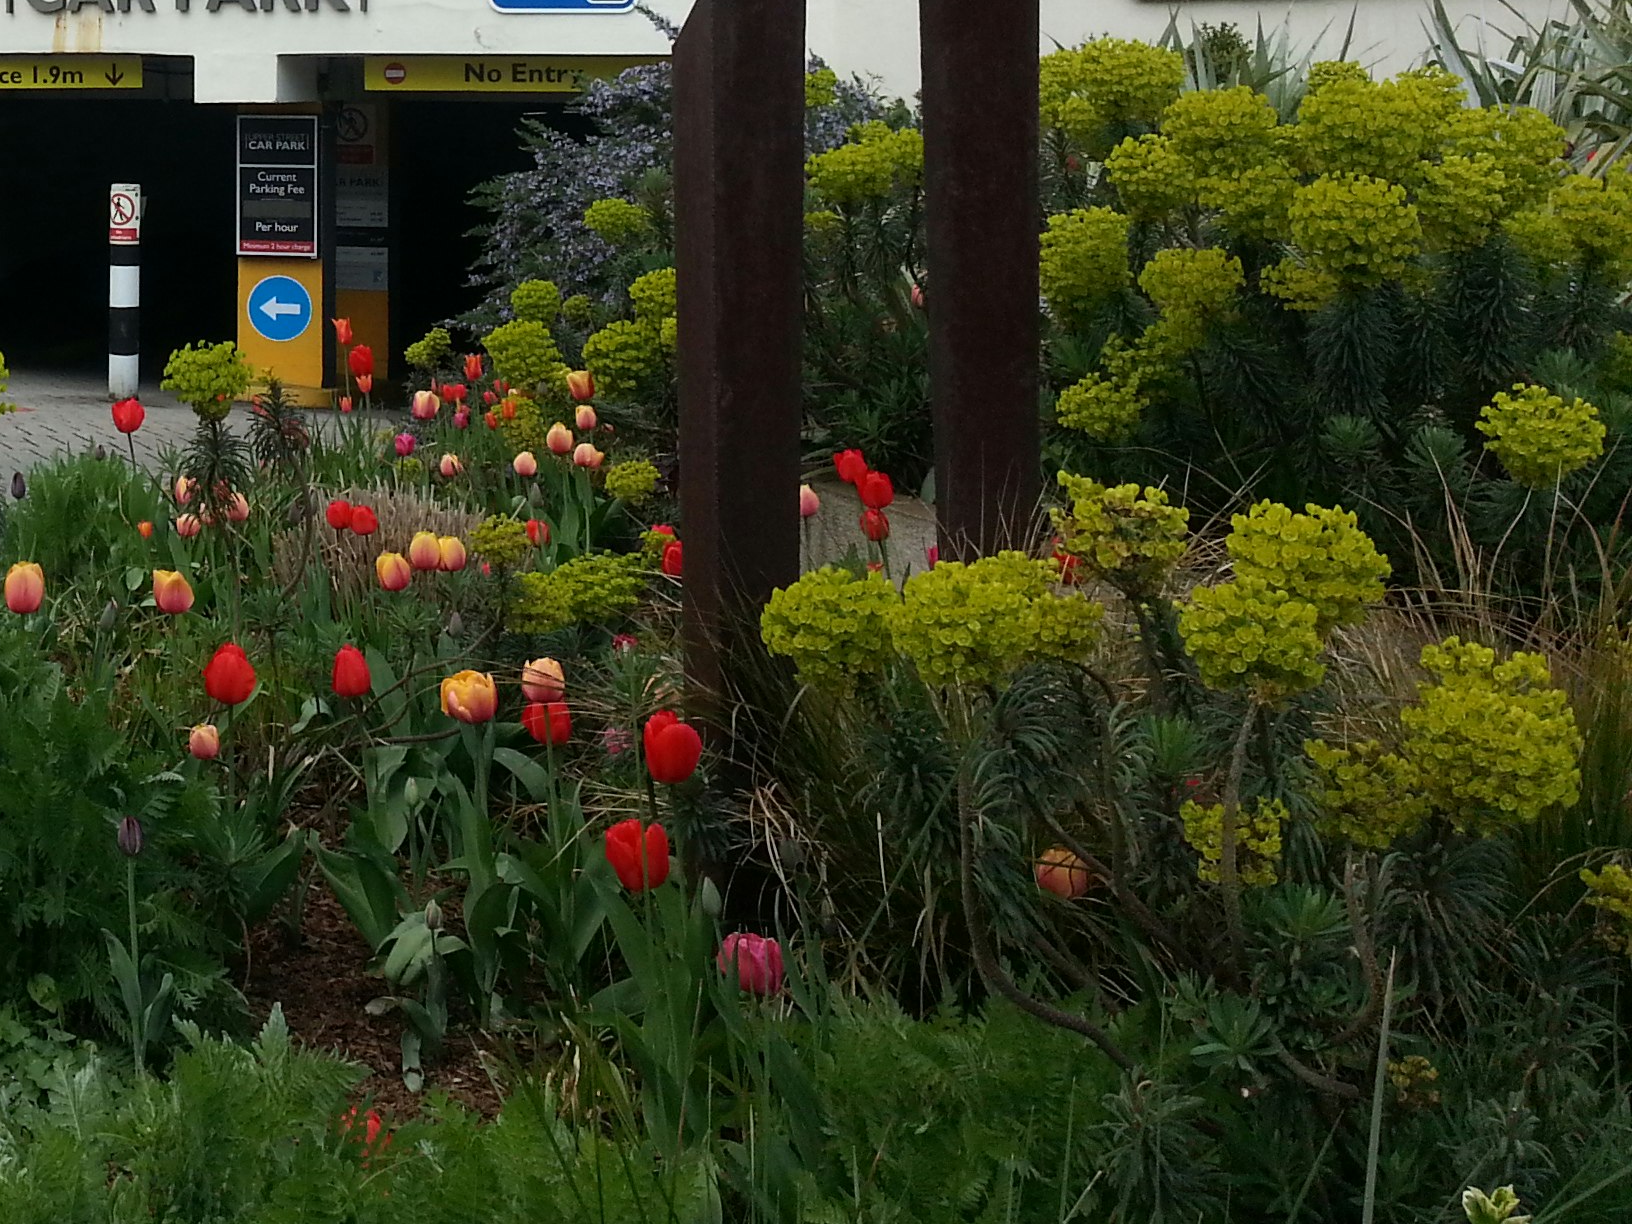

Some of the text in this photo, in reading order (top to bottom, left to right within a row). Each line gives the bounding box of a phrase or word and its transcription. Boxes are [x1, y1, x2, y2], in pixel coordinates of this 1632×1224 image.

[32, 65, 83, 84] 1.9m
[464, 63, 583, 89] No Entry
[248, 141, 305, 151] CAR PARK
[257, 171, 297, 182] Current
[249, 183, 305, 196] Parking Fee
[255, 221, 298, 232] Per hour
